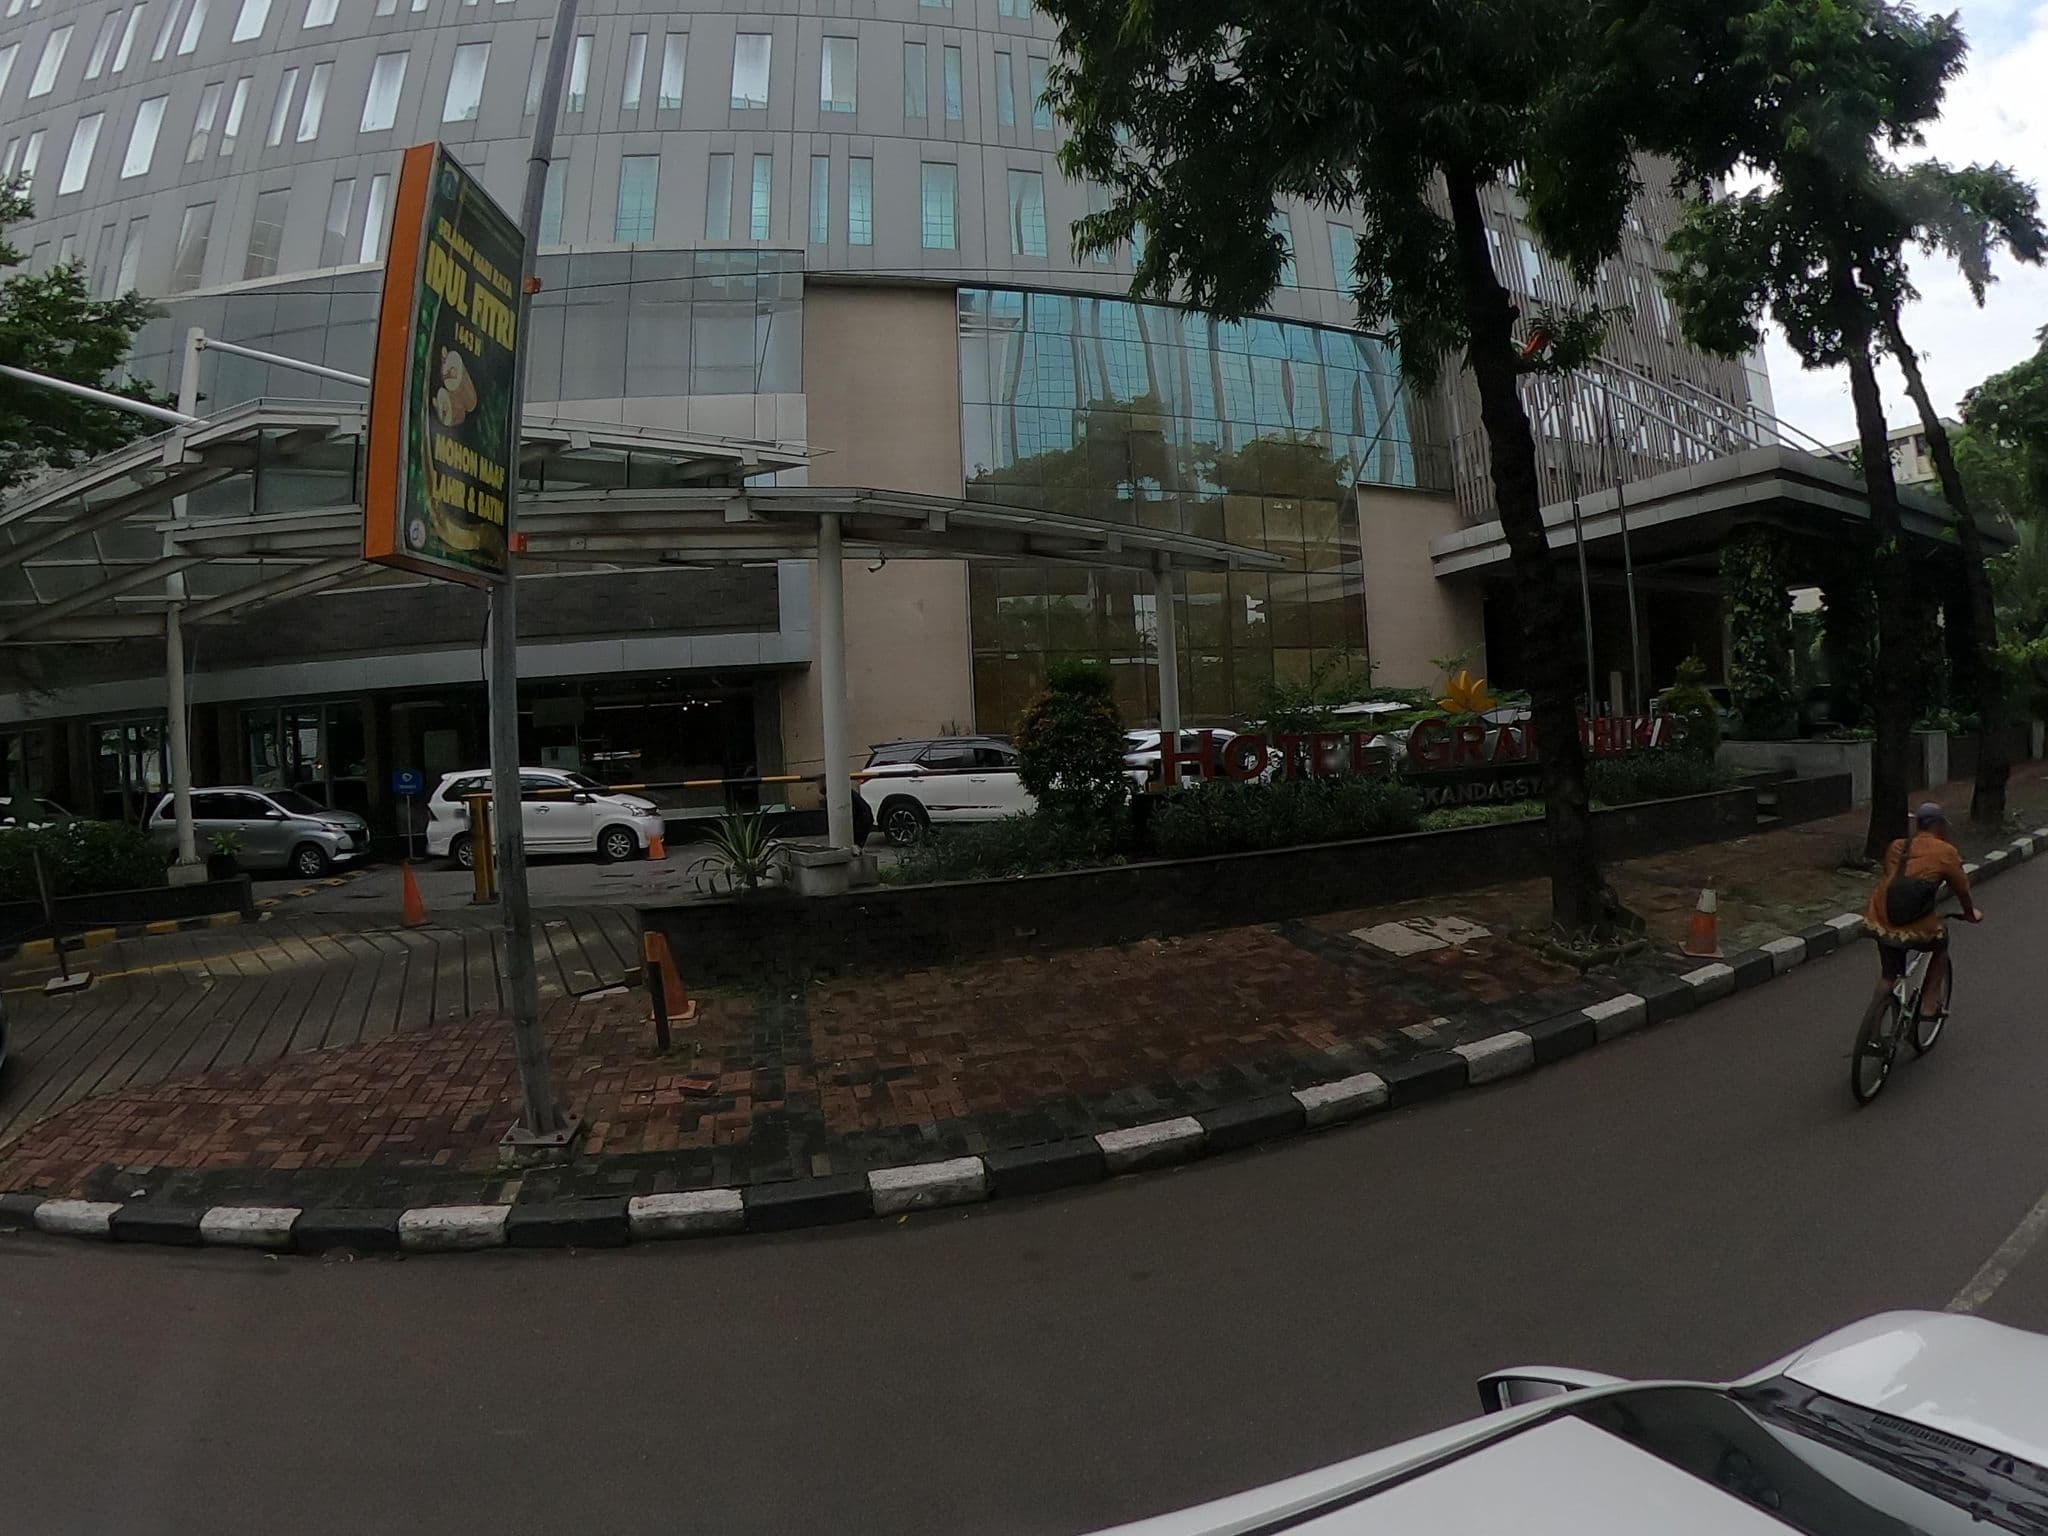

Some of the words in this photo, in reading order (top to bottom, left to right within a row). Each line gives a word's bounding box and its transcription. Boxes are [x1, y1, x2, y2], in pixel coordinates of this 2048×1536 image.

[424, 240, 468, 317] IDUL
[471, 282, 516, 351] FITRI
[434, 433, 478, 478] MOHON
[478, 455, 505, 492] MAAF
[432, 469, 466, 510] LAHIR
[467, 486, 476, 514] &
[478, 490, 504, 527] BATIN
[1161, 730, 1378, 785] HOTEL
